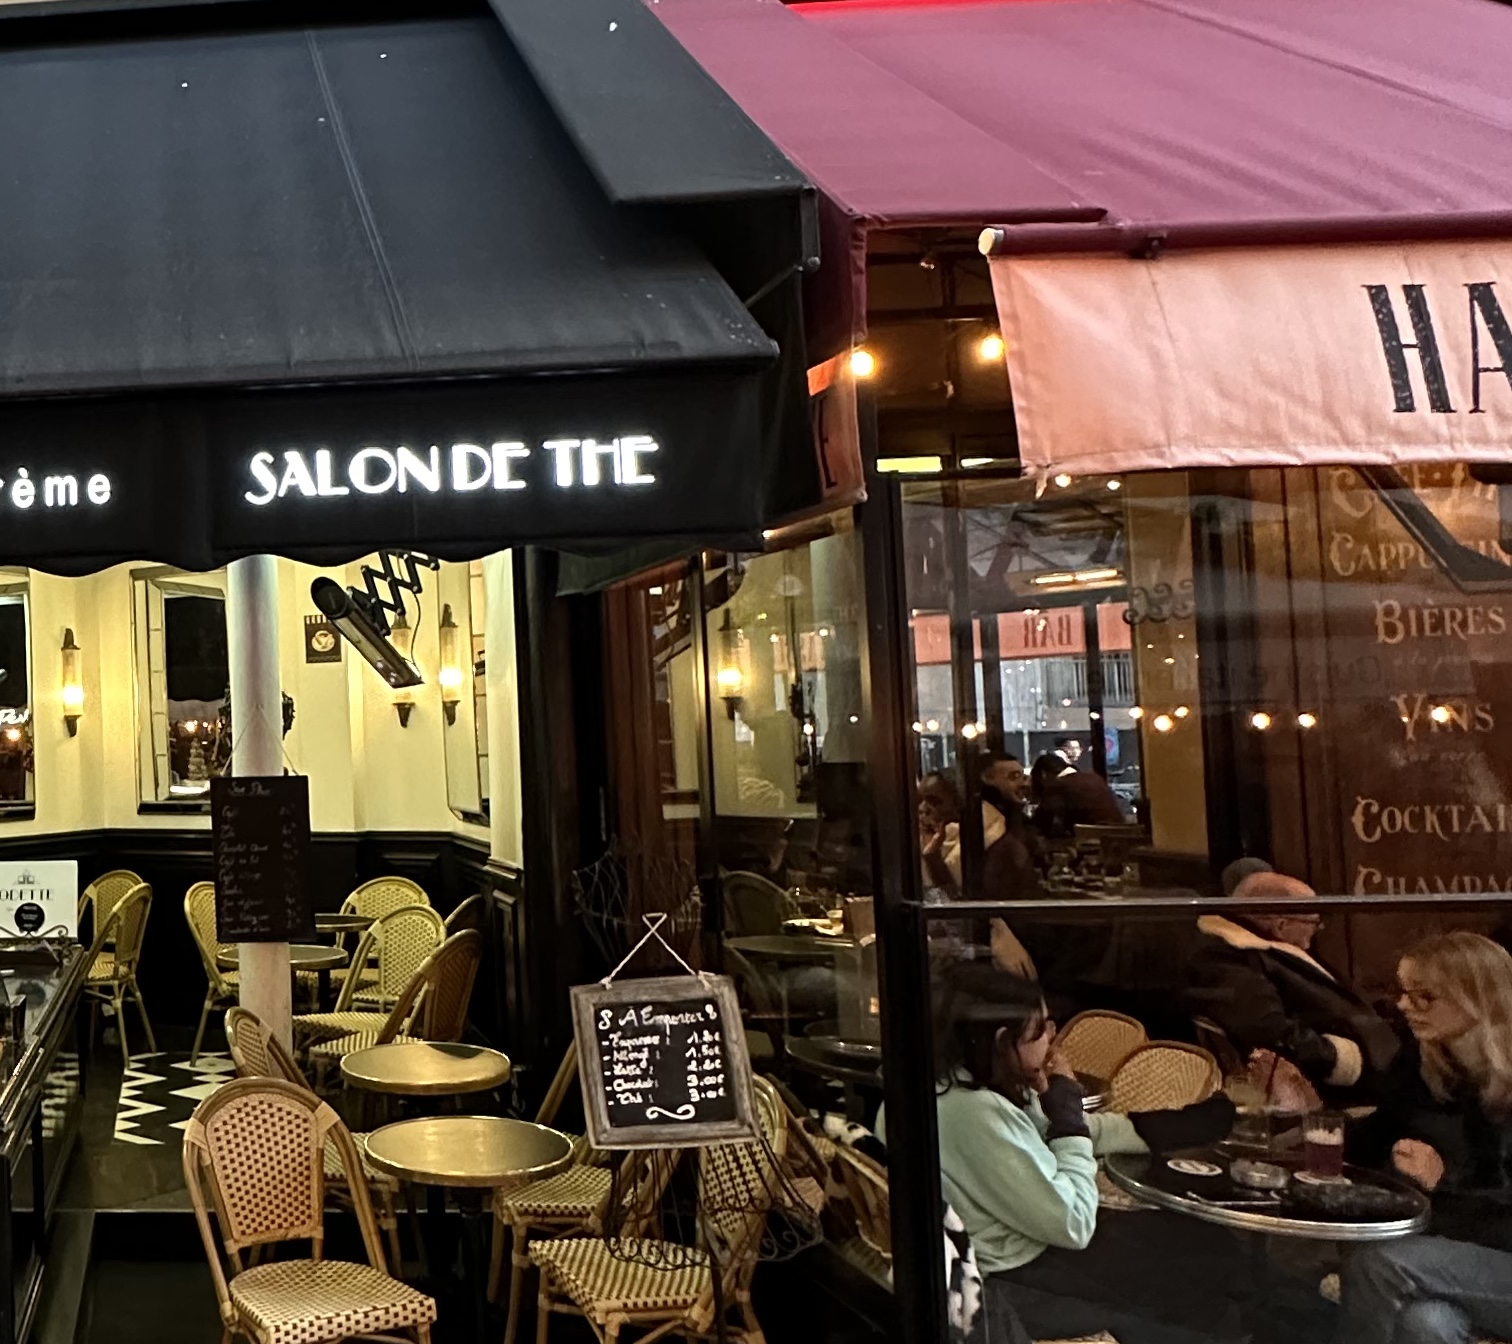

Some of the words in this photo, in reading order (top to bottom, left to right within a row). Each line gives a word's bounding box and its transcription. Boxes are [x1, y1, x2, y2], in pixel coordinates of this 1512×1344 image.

[244, 444, 442, 506] SALON
[449, 441, 531, 492] DE
[1372, 599, 1506, 645] BIÈRES
[1351, 796, 1512, 843] COCKTAI
[640, 1005, 705, 1036] Emporter
